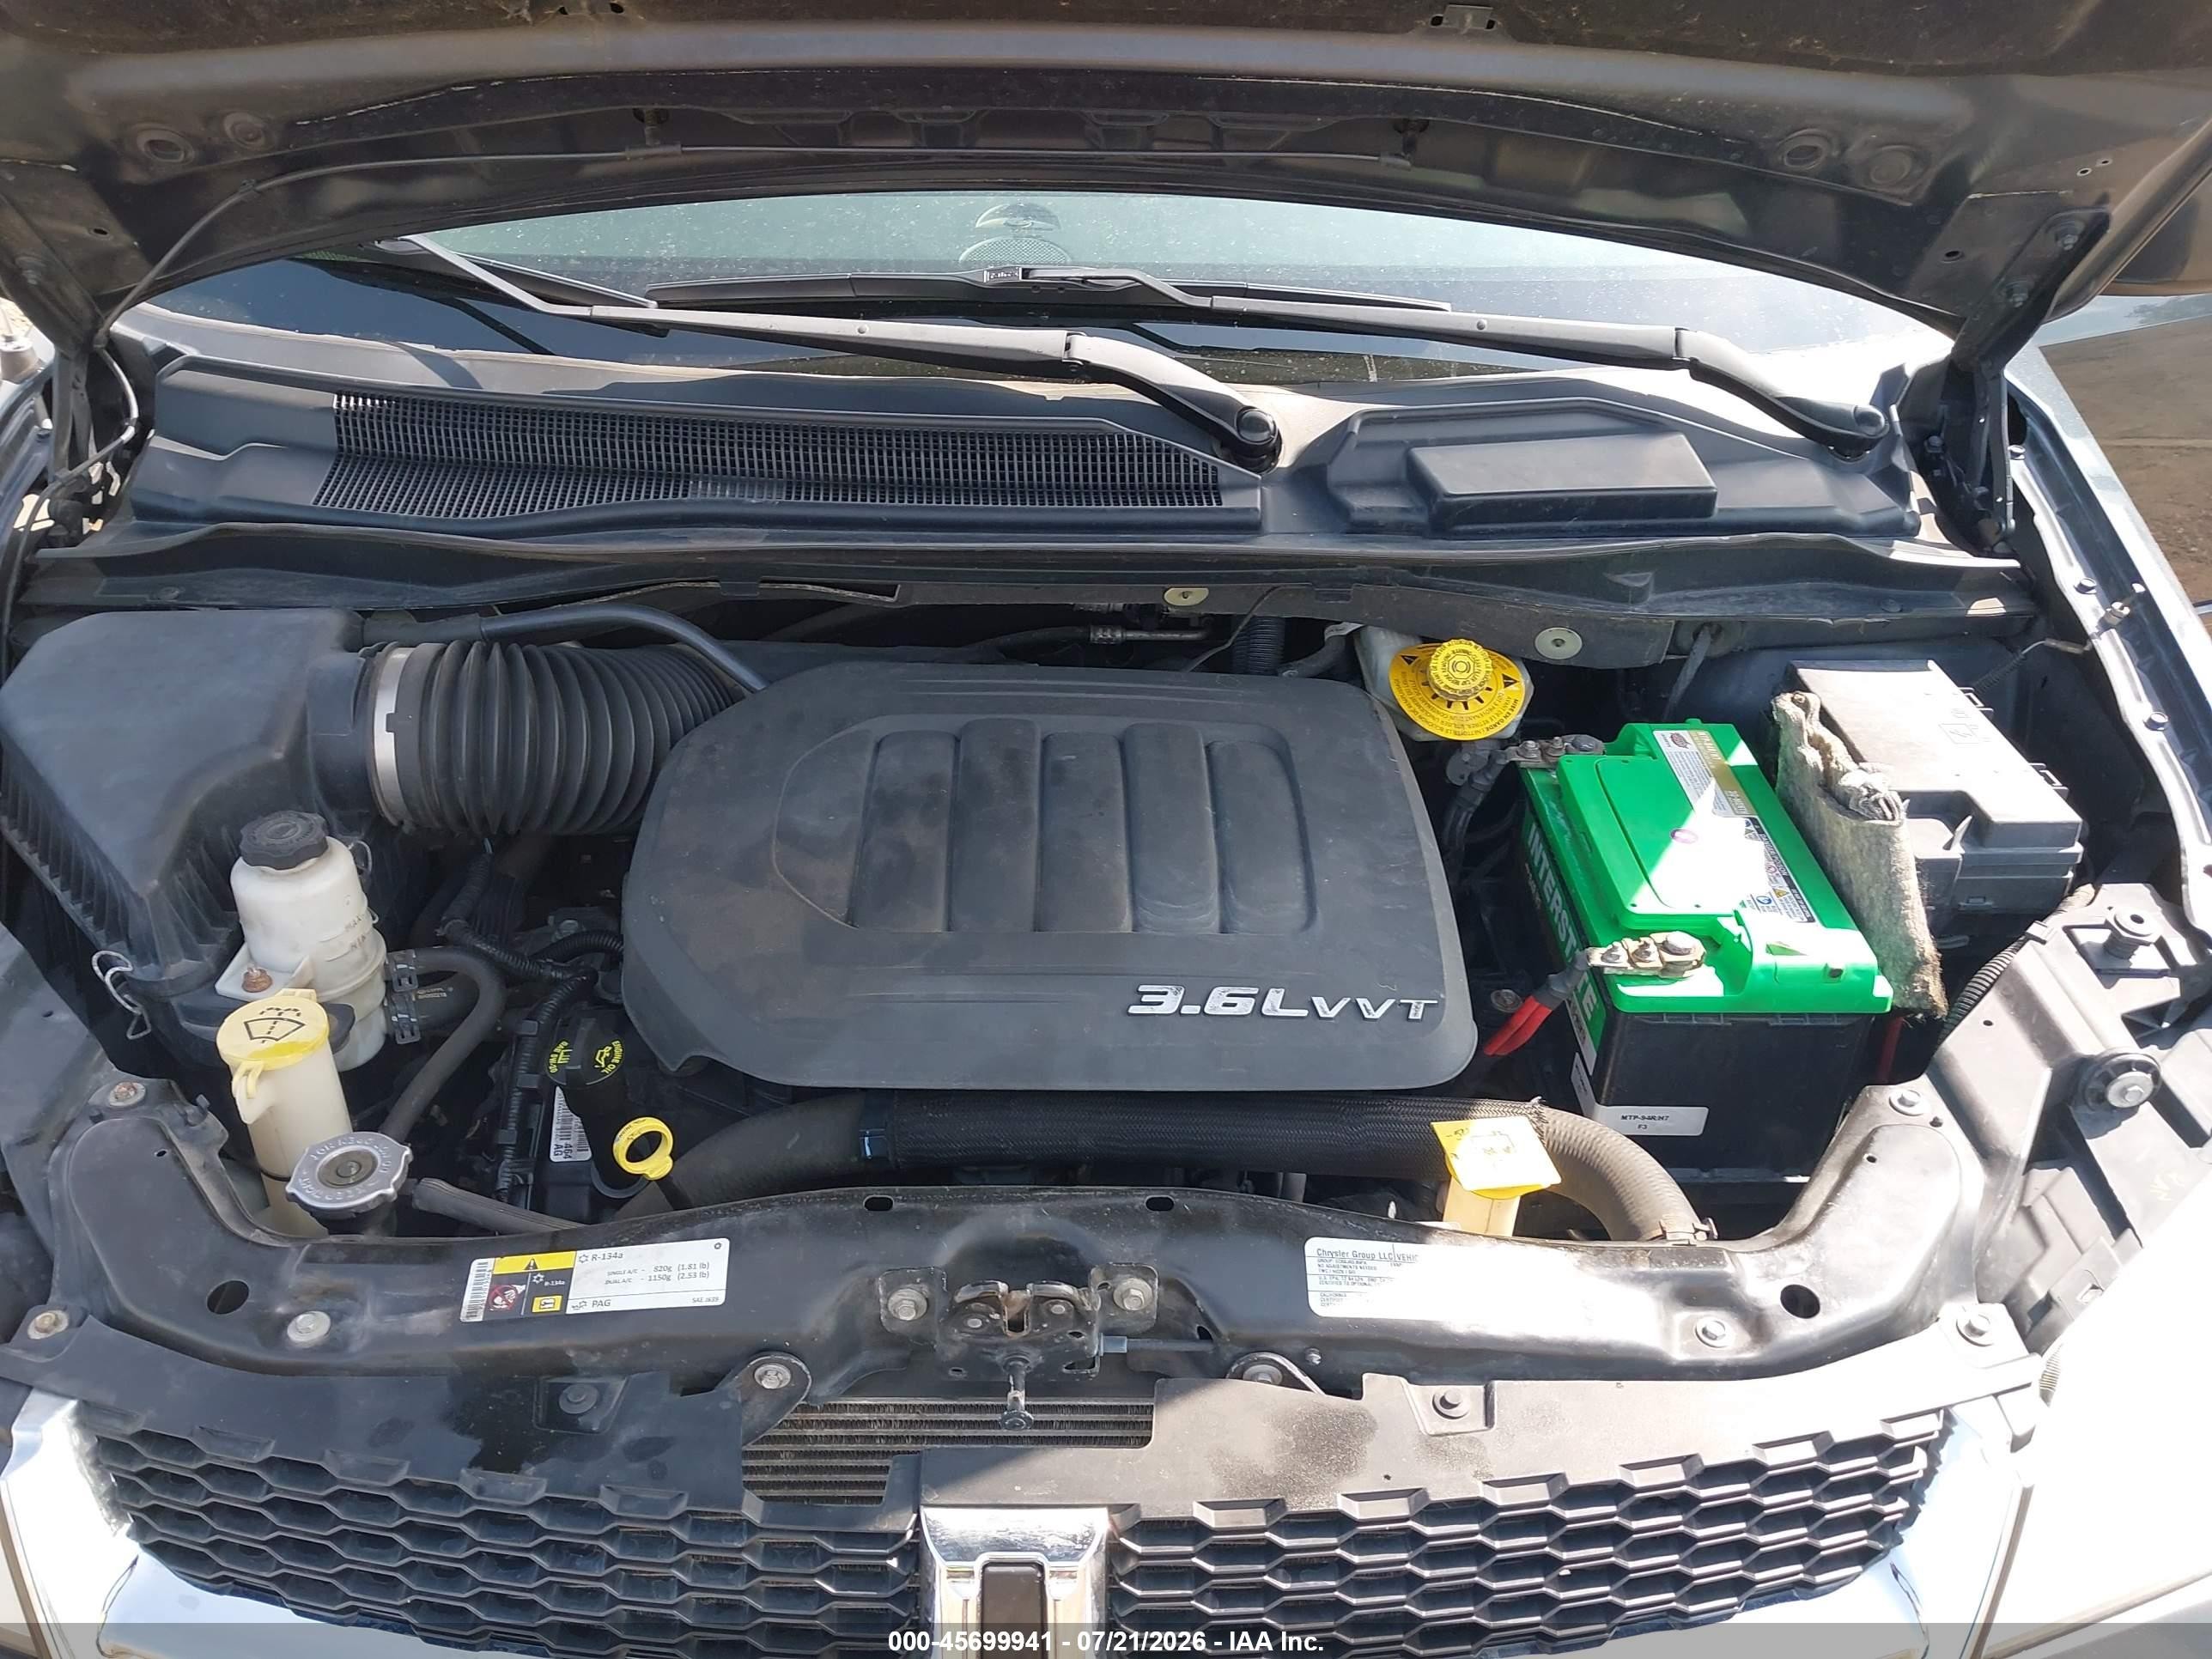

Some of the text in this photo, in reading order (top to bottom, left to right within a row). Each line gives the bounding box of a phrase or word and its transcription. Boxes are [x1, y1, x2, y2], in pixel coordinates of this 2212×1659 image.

[1528, 822, 1598, 1020] INTERSTTE
[600, 1040, 623, 1073] ENGINE OIL
[591, 1252, 623, 1261] R-134a
[1316, 1248, 1349, 1258] Chrysler
[1352, 1250, 1376, 1260] Group
[1378, 1251, 1394, 1260] LLC
[592, 1299, 611, 1308] PAG
